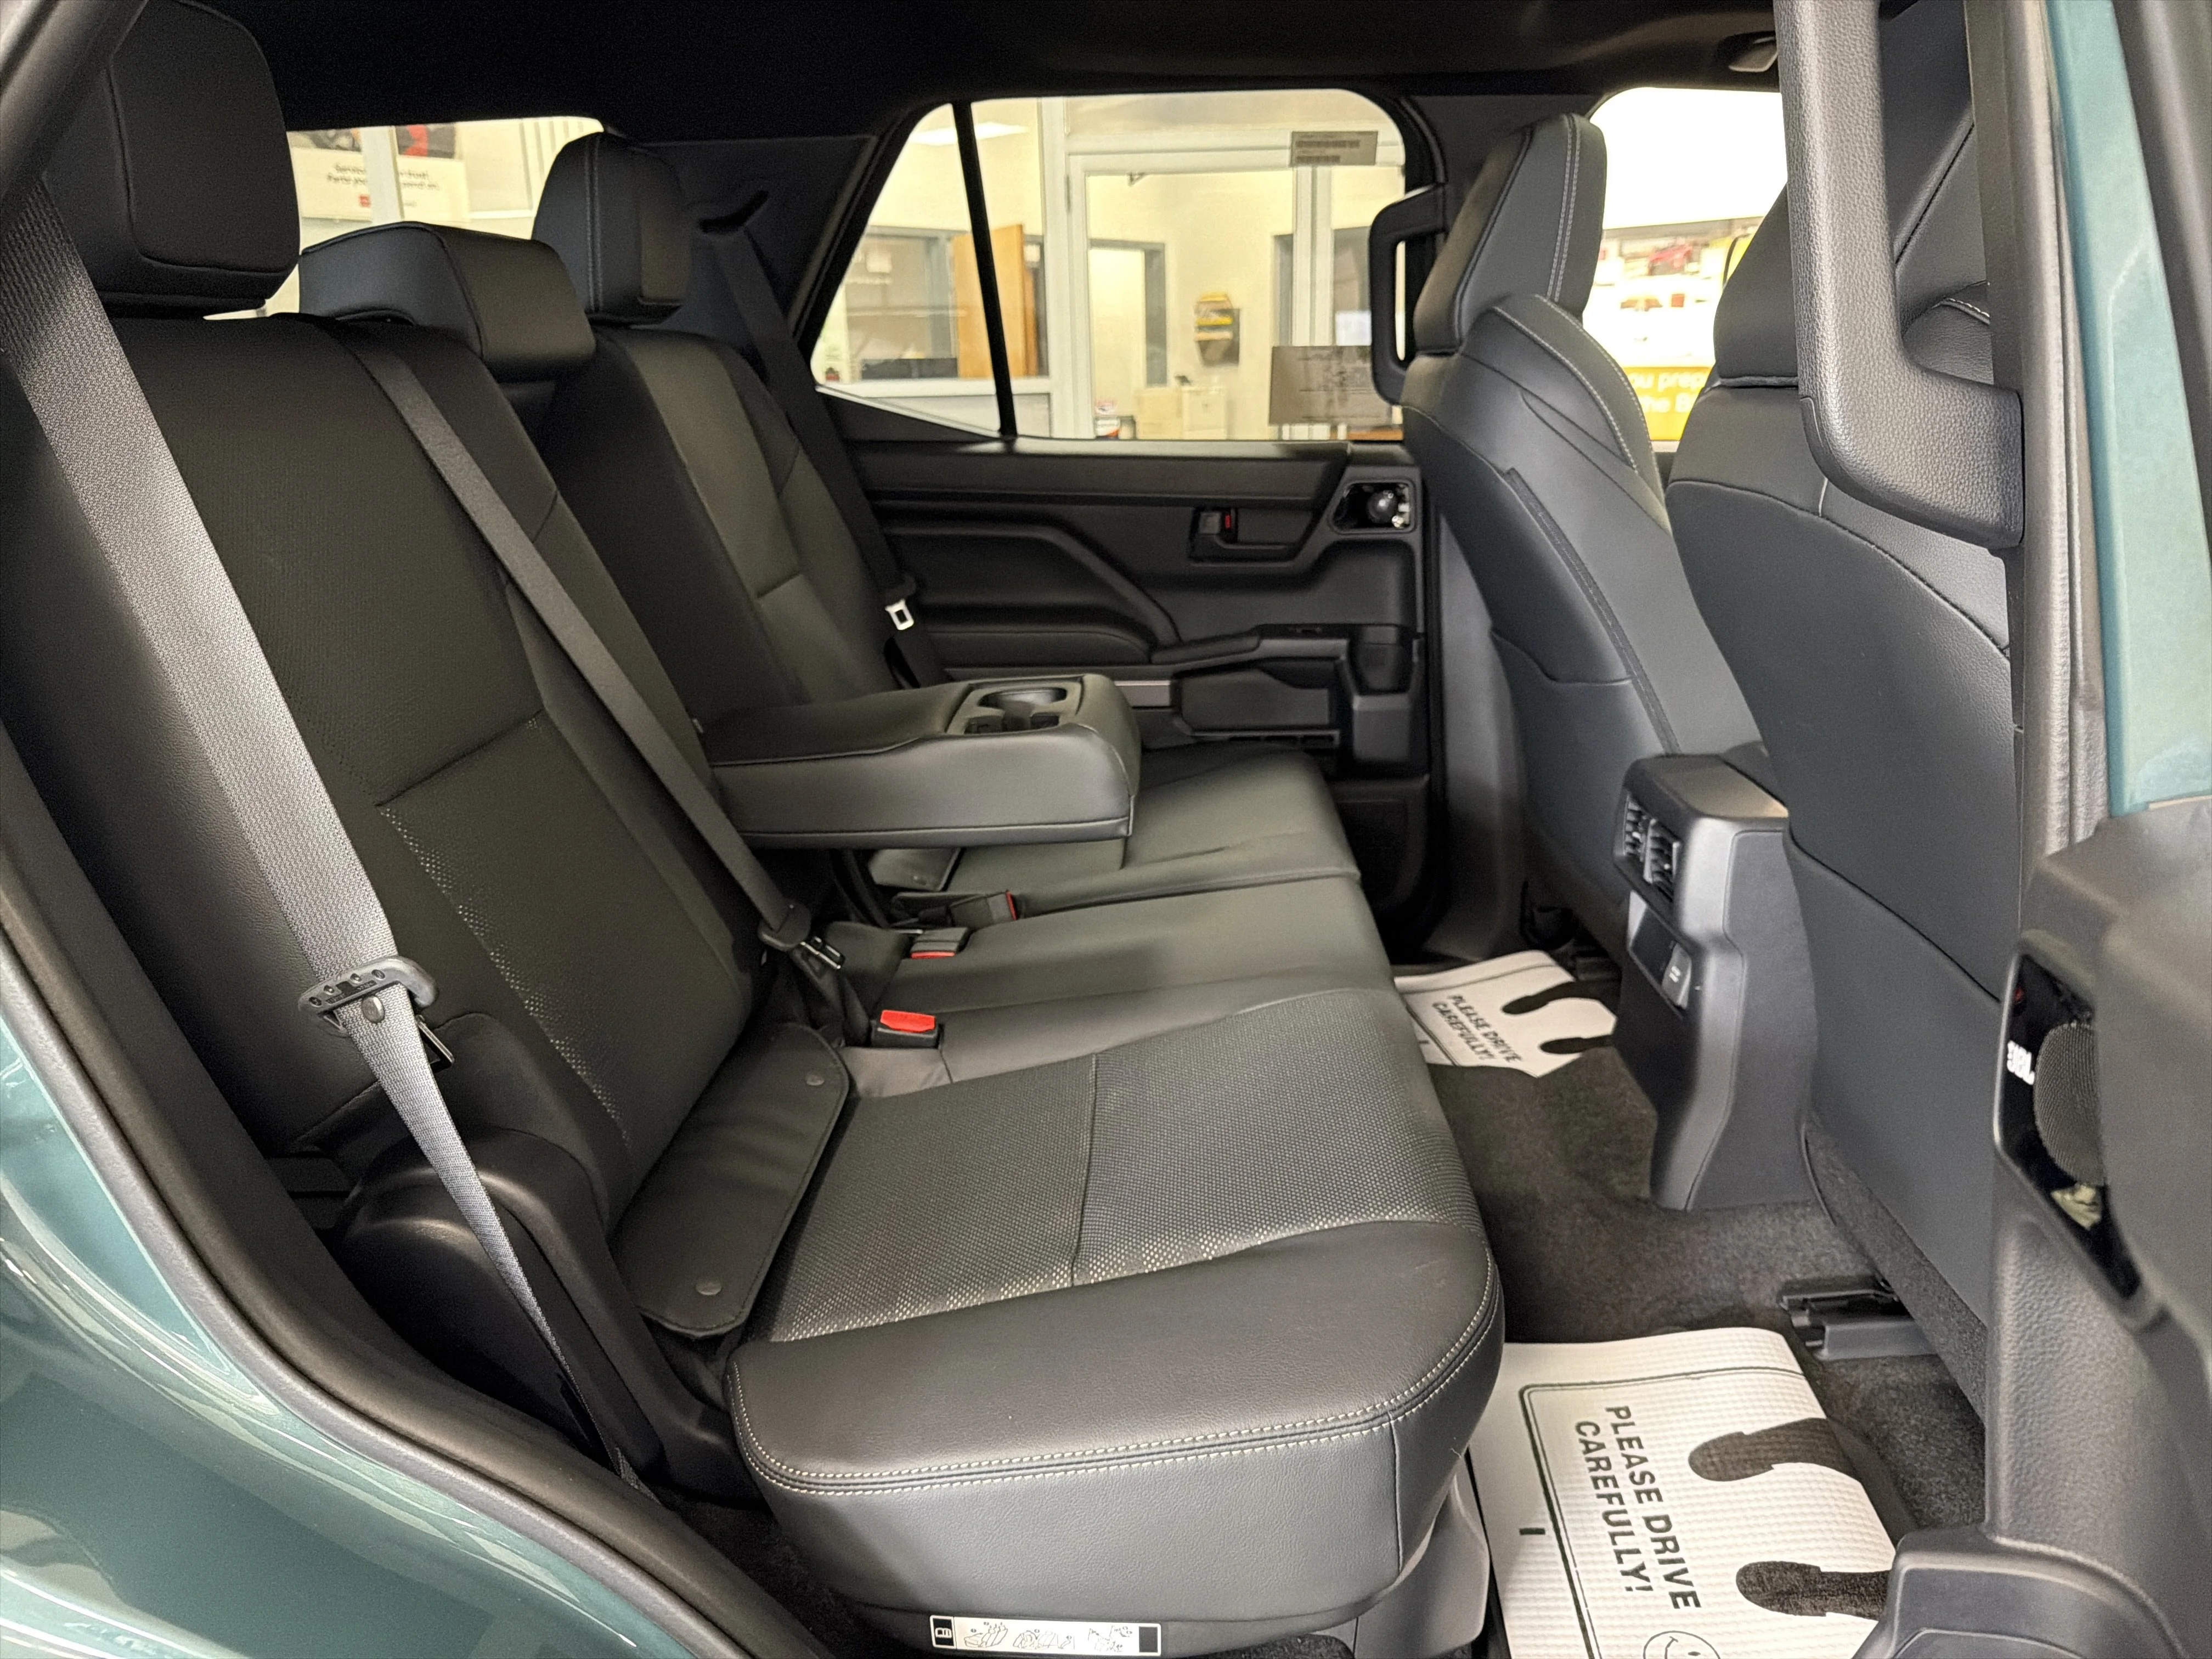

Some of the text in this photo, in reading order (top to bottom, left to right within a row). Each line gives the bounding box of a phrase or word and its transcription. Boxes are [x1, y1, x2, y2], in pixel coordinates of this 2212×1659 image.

[1575, 1420, 1654, 1592] CAREFULLY!
[1605, 1405, 1702, 1609] PLEASE DRIVE
